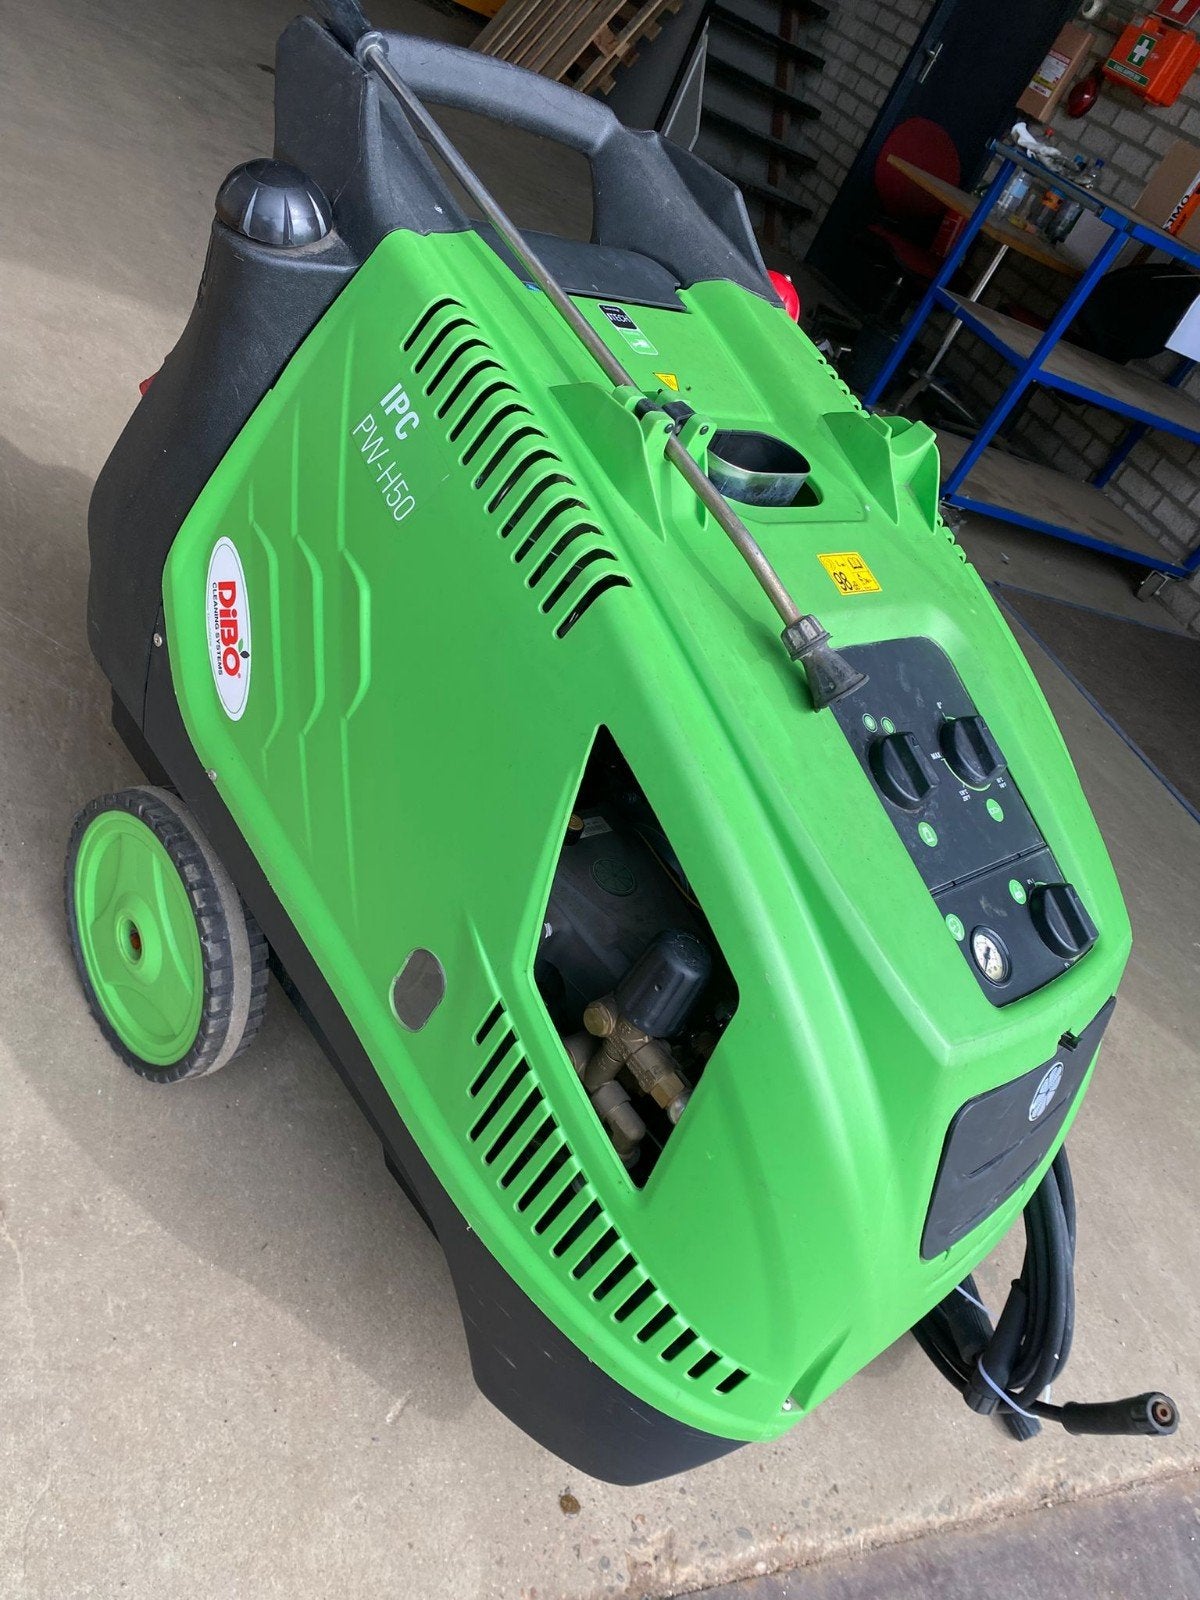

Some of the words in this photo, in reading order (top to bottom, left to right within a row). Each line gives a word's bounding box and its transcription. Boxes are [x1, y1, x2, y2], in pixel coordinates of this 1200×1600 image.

[380, 383, 420, 440] IPC
[352, 413, 416, 521] PW-H50
[215, 632, 223, 675] SYSTEMS
